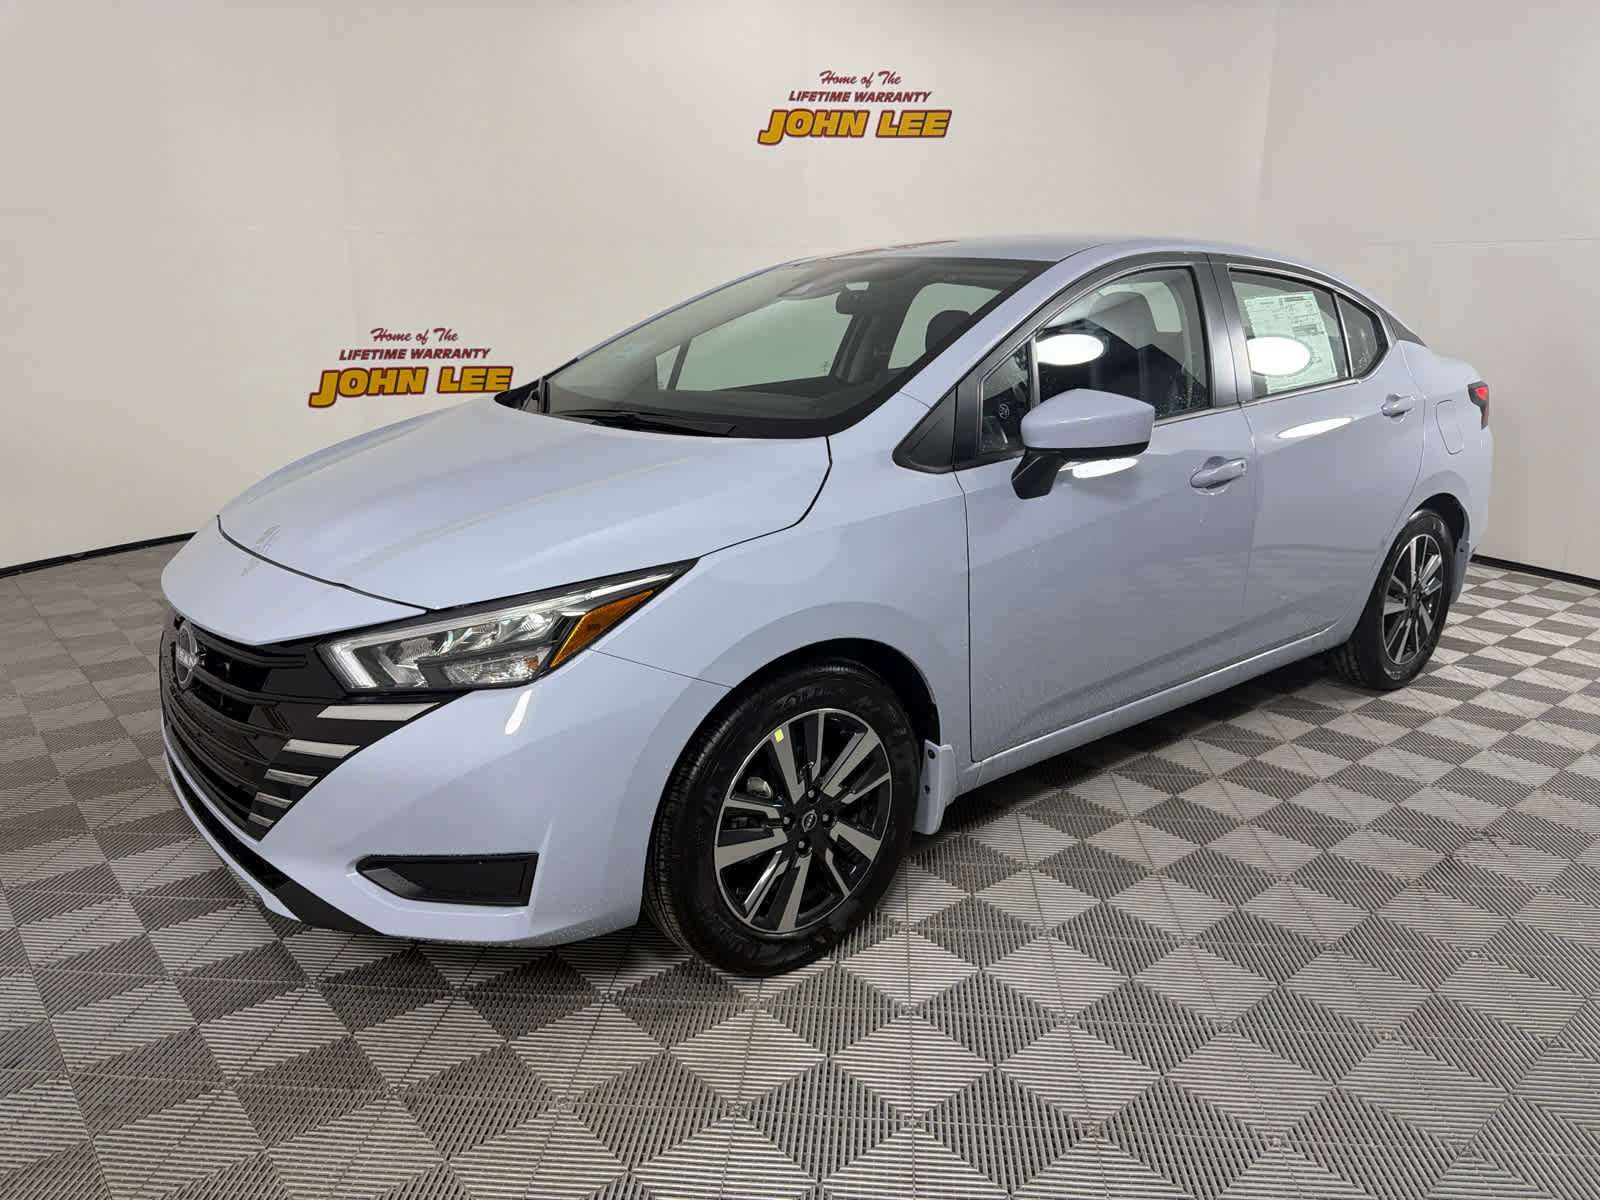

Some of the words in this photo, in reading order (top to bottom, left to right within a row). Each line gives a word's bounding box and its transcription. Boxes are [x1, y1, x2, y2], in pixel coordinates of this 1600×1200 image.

[819, 70, 857, 85] Home
[861, 72, 874, 88] of
[878, 70, 902, 85] The
[788, 91, 851, 102] LIFETIME
[854, 91, 932, 102] WARRANTY
[757, 108, 870, 146] JOHN
[875, 109, 952, 138] LEE
[370, 328, 412, 342] Home
[415, 329, 430, 345] of
[433, 328, 458, 342] The
[339, 349, 408, 361] LIFETIME
[410, 348, 491, 360] WARRANTY
[308, 366, 429, 408] JOHN
[437, 366, 514, 393] LEE
